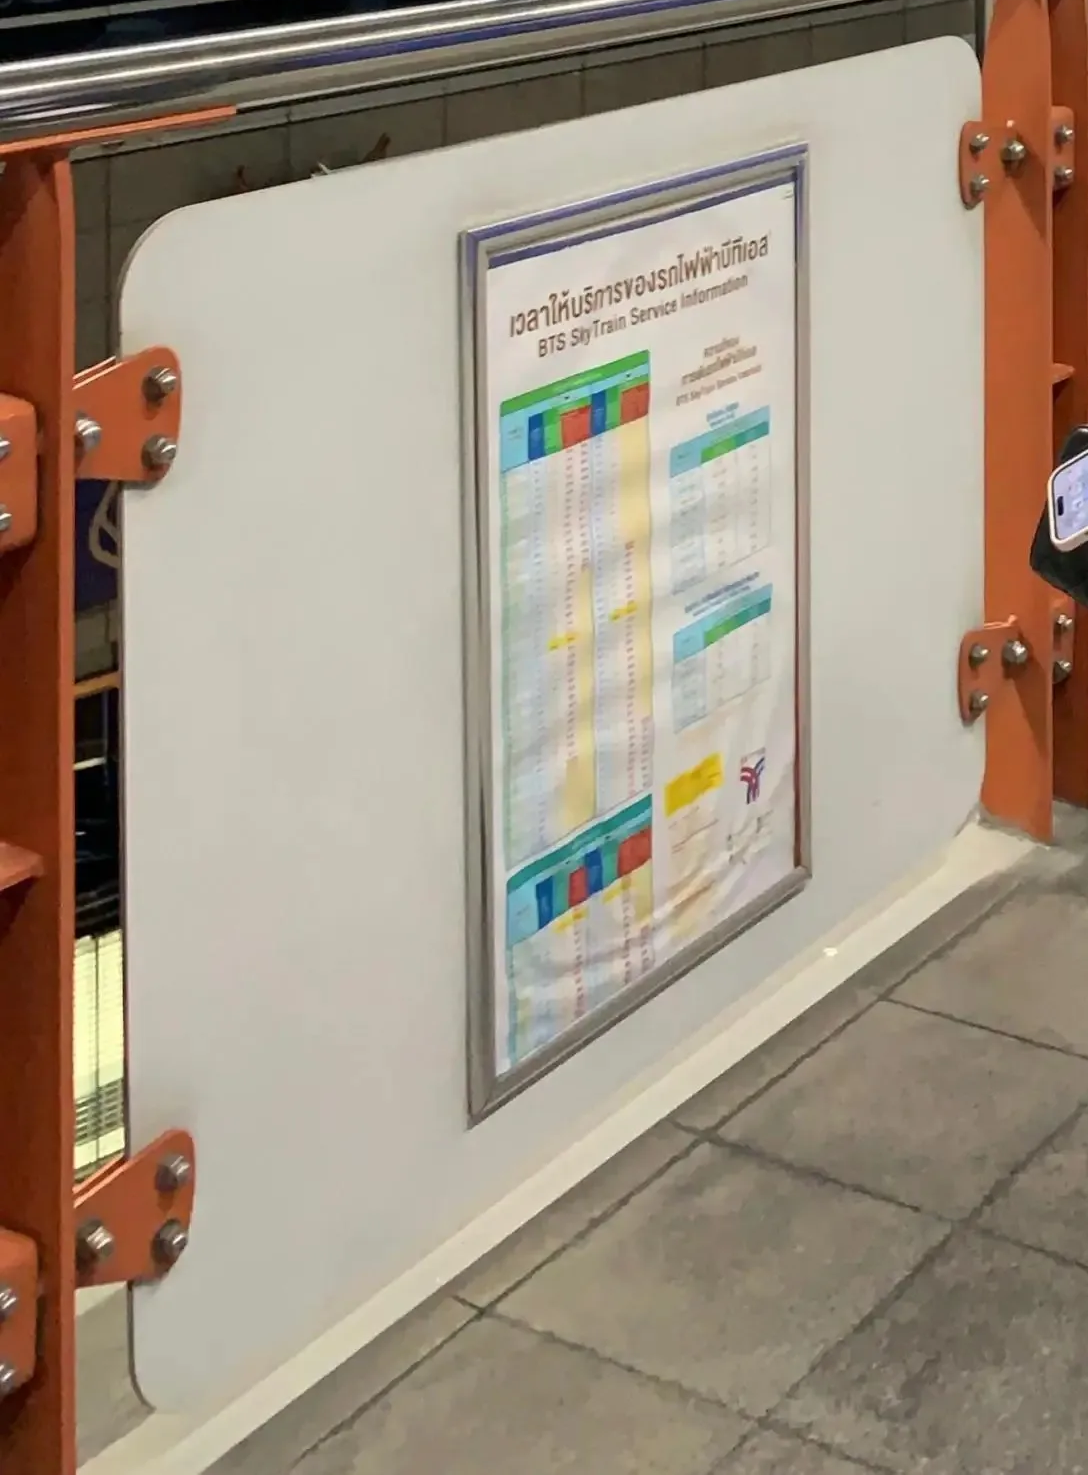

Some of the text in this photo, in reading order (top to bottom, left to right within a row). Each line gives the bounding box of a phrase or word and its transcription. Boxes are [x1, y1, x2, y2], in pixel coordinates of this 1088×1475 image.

[538, 332, 566, 358] BTS
[631, 297, 677, 326] Service
[681, 274, 748, 310] Information
